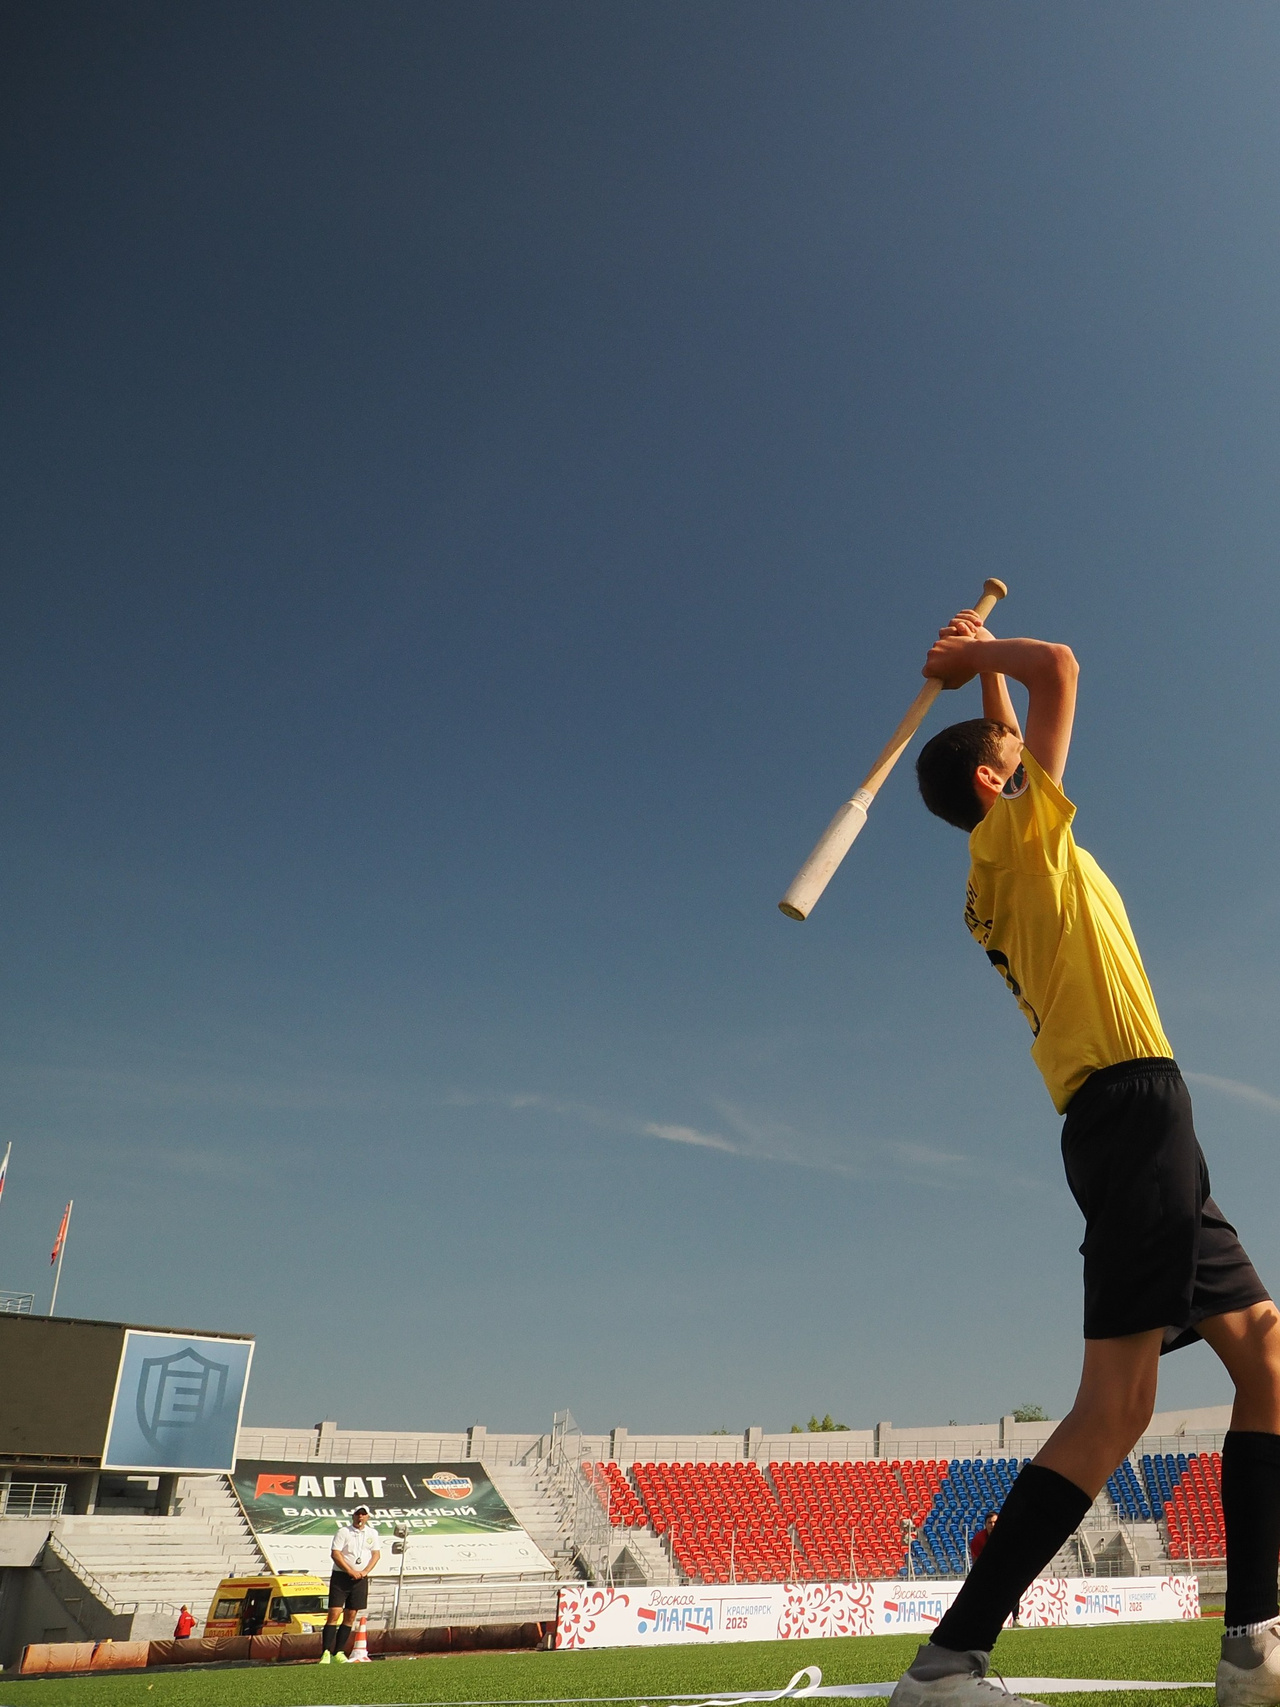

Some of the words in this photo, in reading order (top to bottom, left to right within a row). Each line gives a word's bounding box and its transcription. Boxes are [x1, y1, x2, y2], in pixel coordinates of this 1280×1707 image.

[297, 1475, 387, 1498] АГАТ
[282, 1507, 337, 1517] ВАШ
[648, 1589, 696, 1607] Русская
[891, 1585, 928, 1600] Русская
[726, 1605, 772, 1616] КРАСНОЯРСК
[896, 1600, 942, 1623] ЛАПТА
[1085, 1594, 1122, 1614] ЛАПТА
[1128, 1602, 1143, 1612] 2025
[653, 1607, 713, 1632] ЛАПТА
[725, 1617, 748, 1630] 2025
